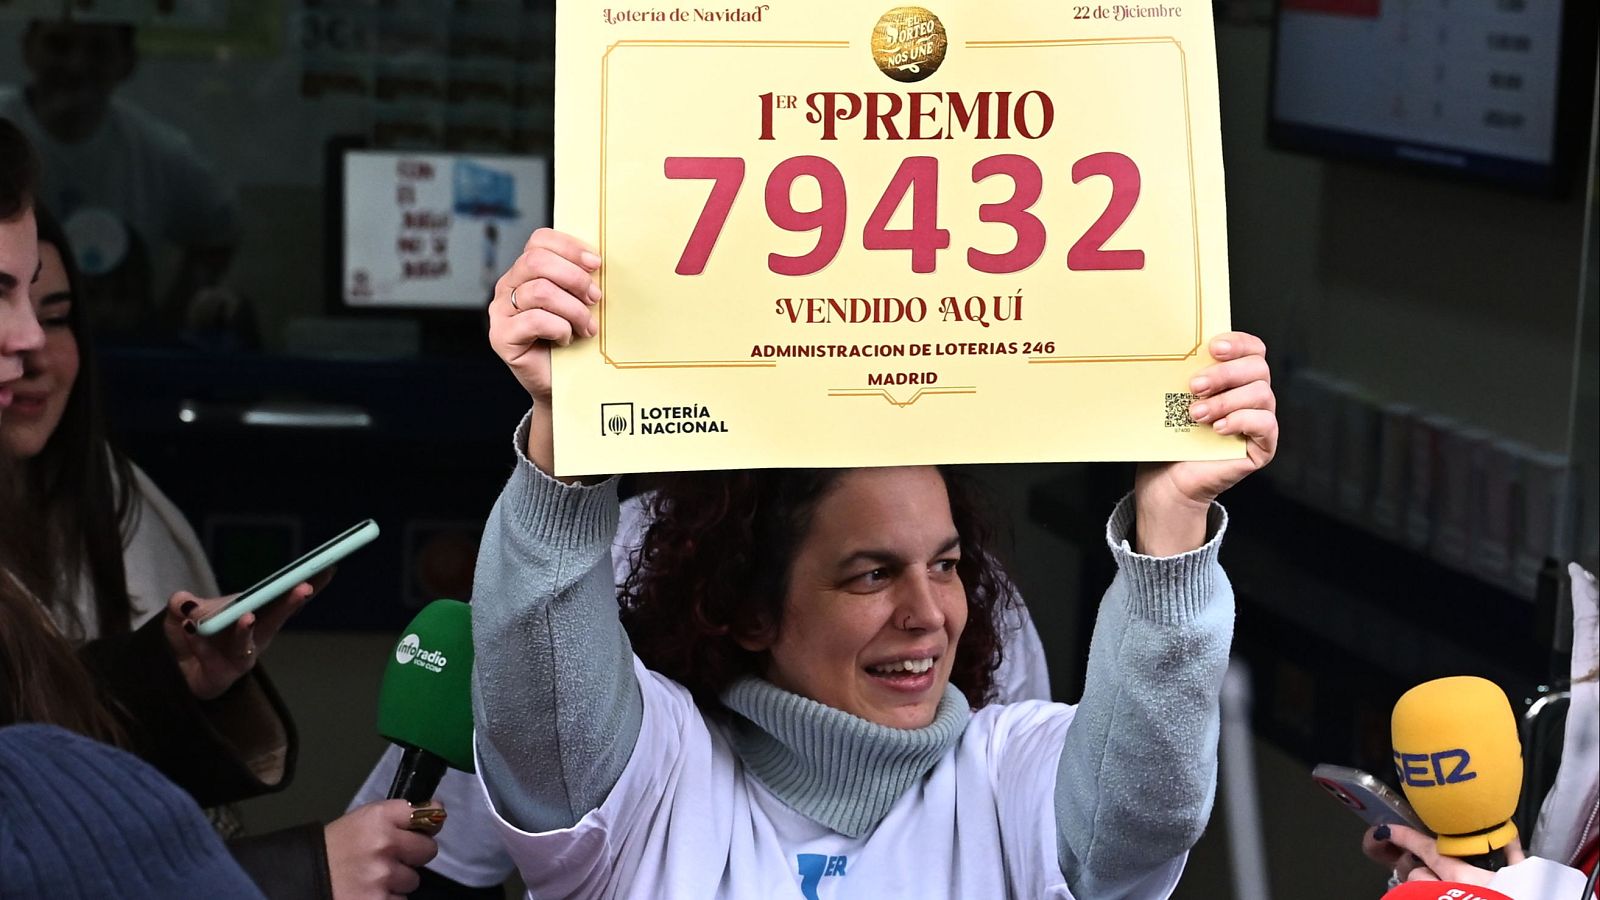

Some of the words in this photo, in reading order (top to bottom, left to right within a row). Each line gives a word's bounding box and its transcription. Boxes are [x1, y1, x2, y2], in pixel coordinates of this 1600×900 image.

[603, 7, 666, 25] Lotería
[670, 7, 690, 22] de
[694, 4, 770, 22] Navidad
[1072, 5, 1091, 20] 22
[1093, 5, 1110, 19] de
[1112, 4, 1182, 21] Diciembre
[887, 51, 909, 68] NOS
[910, 41, 934, 60] UNE
[805, 90, 1055, 141] PREMIO
[664, 151, 1146, 277] 79432
[775, 296, 928, 324] VENDIDO
[938, 288, 1024, 328] AQUÍ
[750, 344, 905, 358] ADMINISTRACION
[909, 343, 932, 357] DE
[935, 341, 1018, 356] LOTERIAS
[1022, 341, 1056, 355] 246
[867, 371, 938, 386] MADRID
[641, 403, 711, 420] LOTERÍA
[641, 420, 729, 435] NACIONAL
